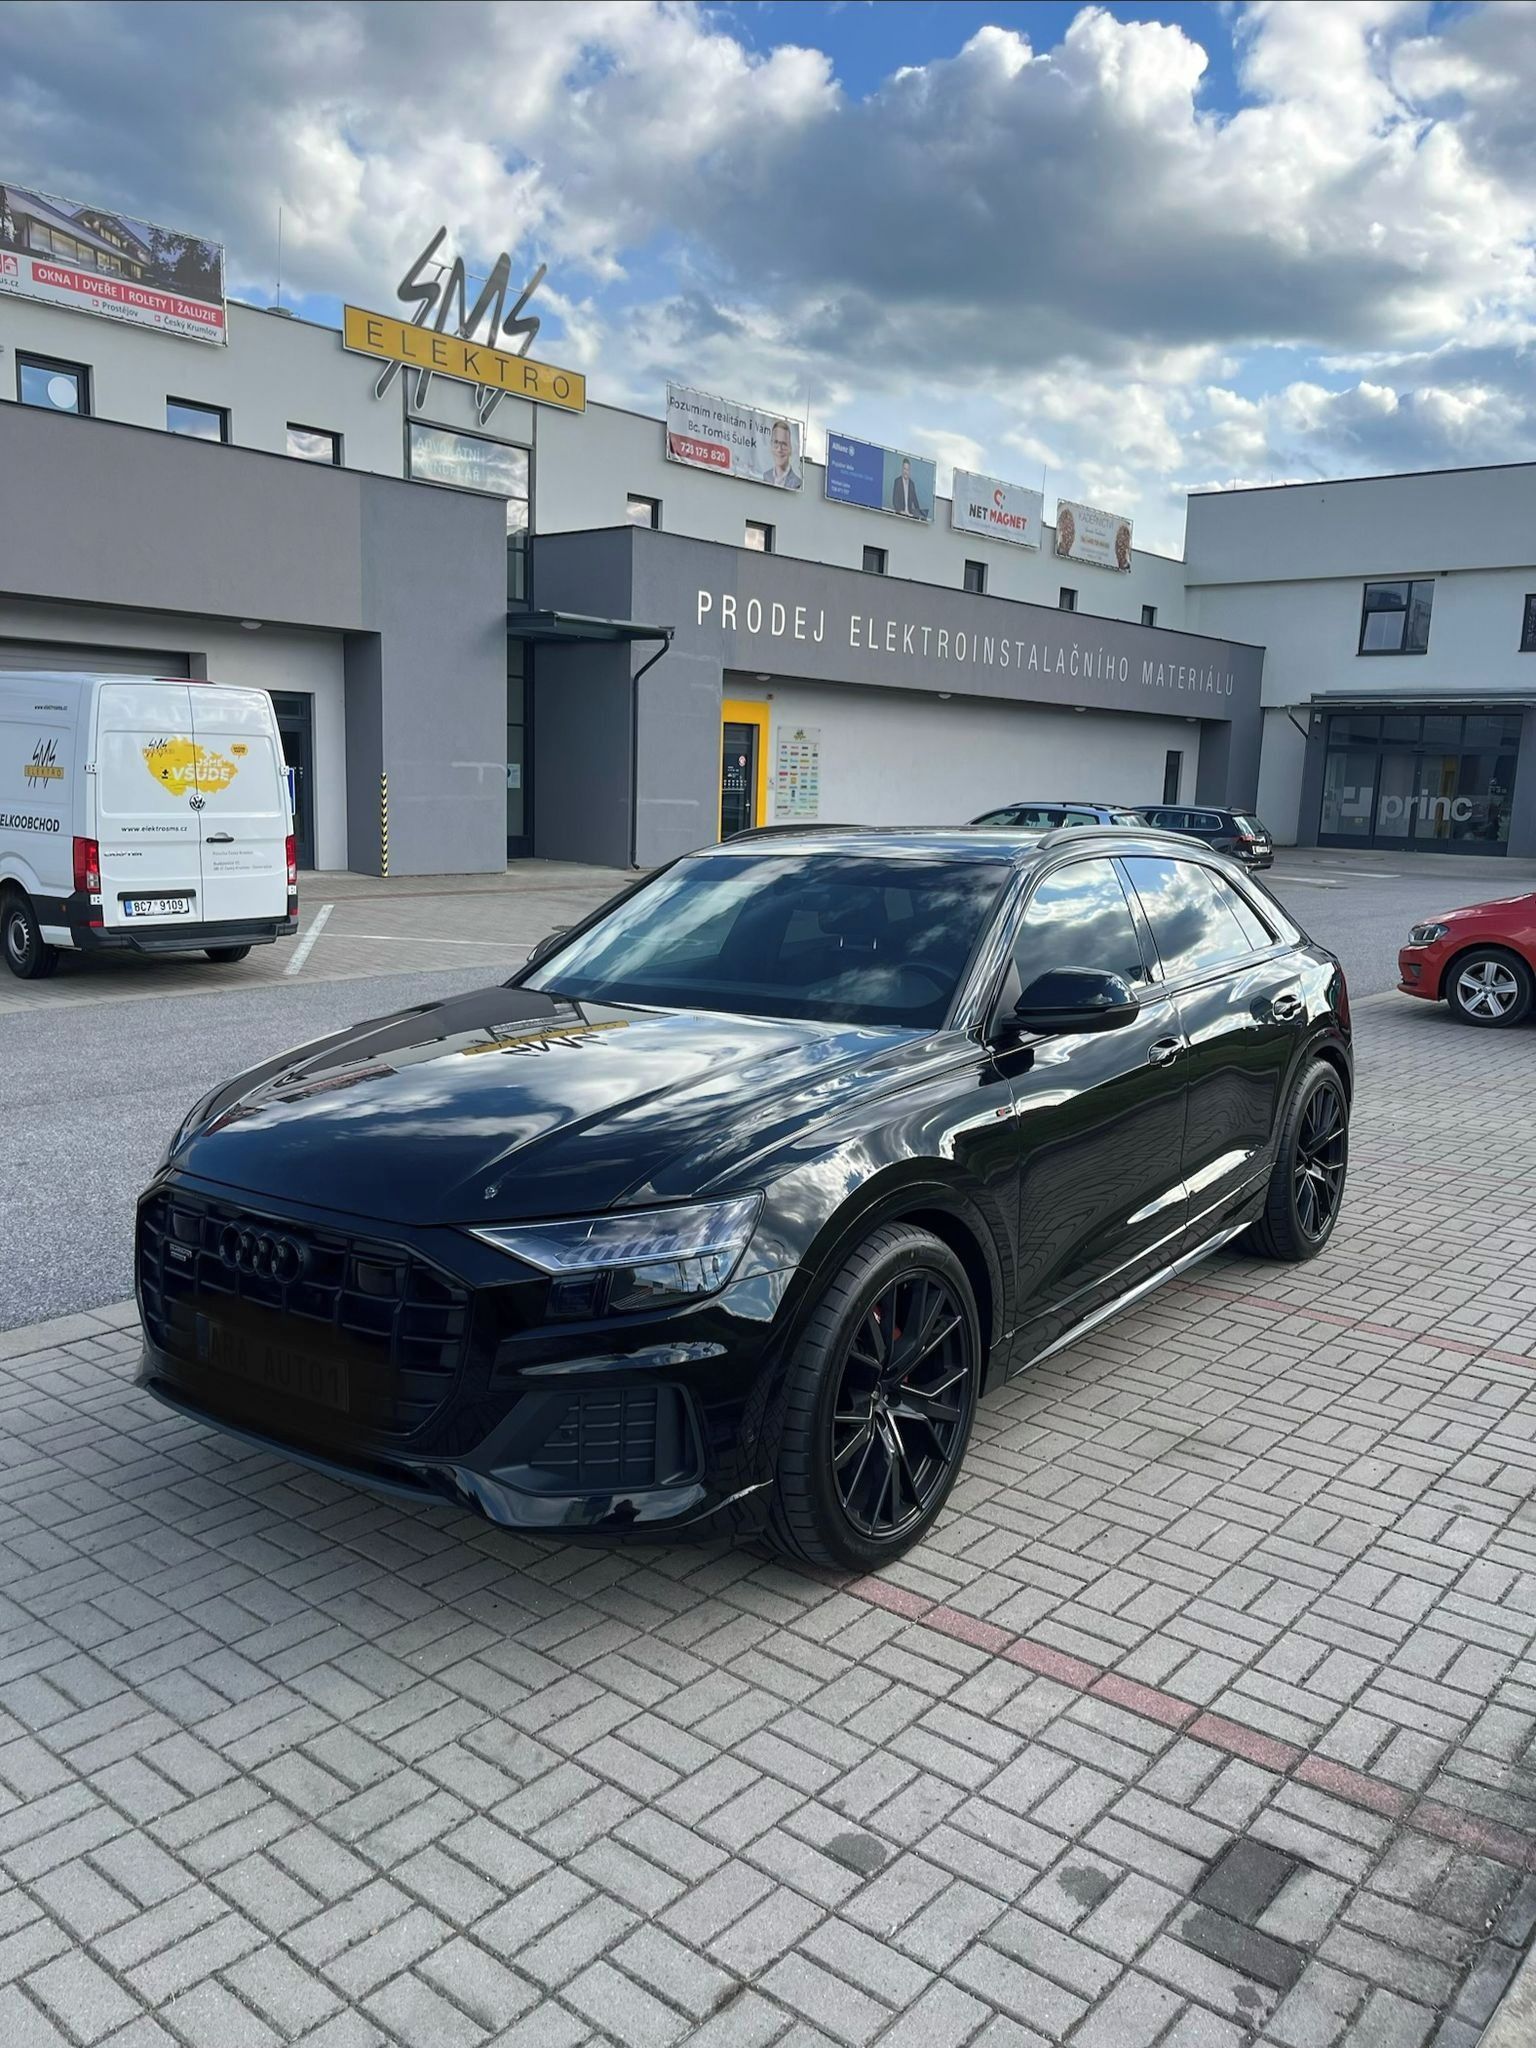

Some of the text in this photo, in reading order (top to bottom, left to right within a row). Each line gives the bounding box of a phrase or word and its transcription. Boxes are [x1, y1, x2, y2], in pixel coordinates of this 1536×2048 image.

[38, 268, 216, 322] OKNA DVEŘE ROLETY ŽALUZIE
[102, 301, 139, 317] Prostějov
[164, 315, 217, 337] Český Krumlov
[367, 320, 569, 398] ELEKTRO
[732, 431, 757, 448] Šulek
[969, 503, 1027, 530] NET MAGNET
[697, 590, 1234, 696] PRODEJ ELEKTROINSTALAČNÍHO MATERIÁLU
[172, 763, 230, 781] VŠUDE
[1379, 789, 1472, 825] princ
[134, 900, 183, 912] 8C7 9109
